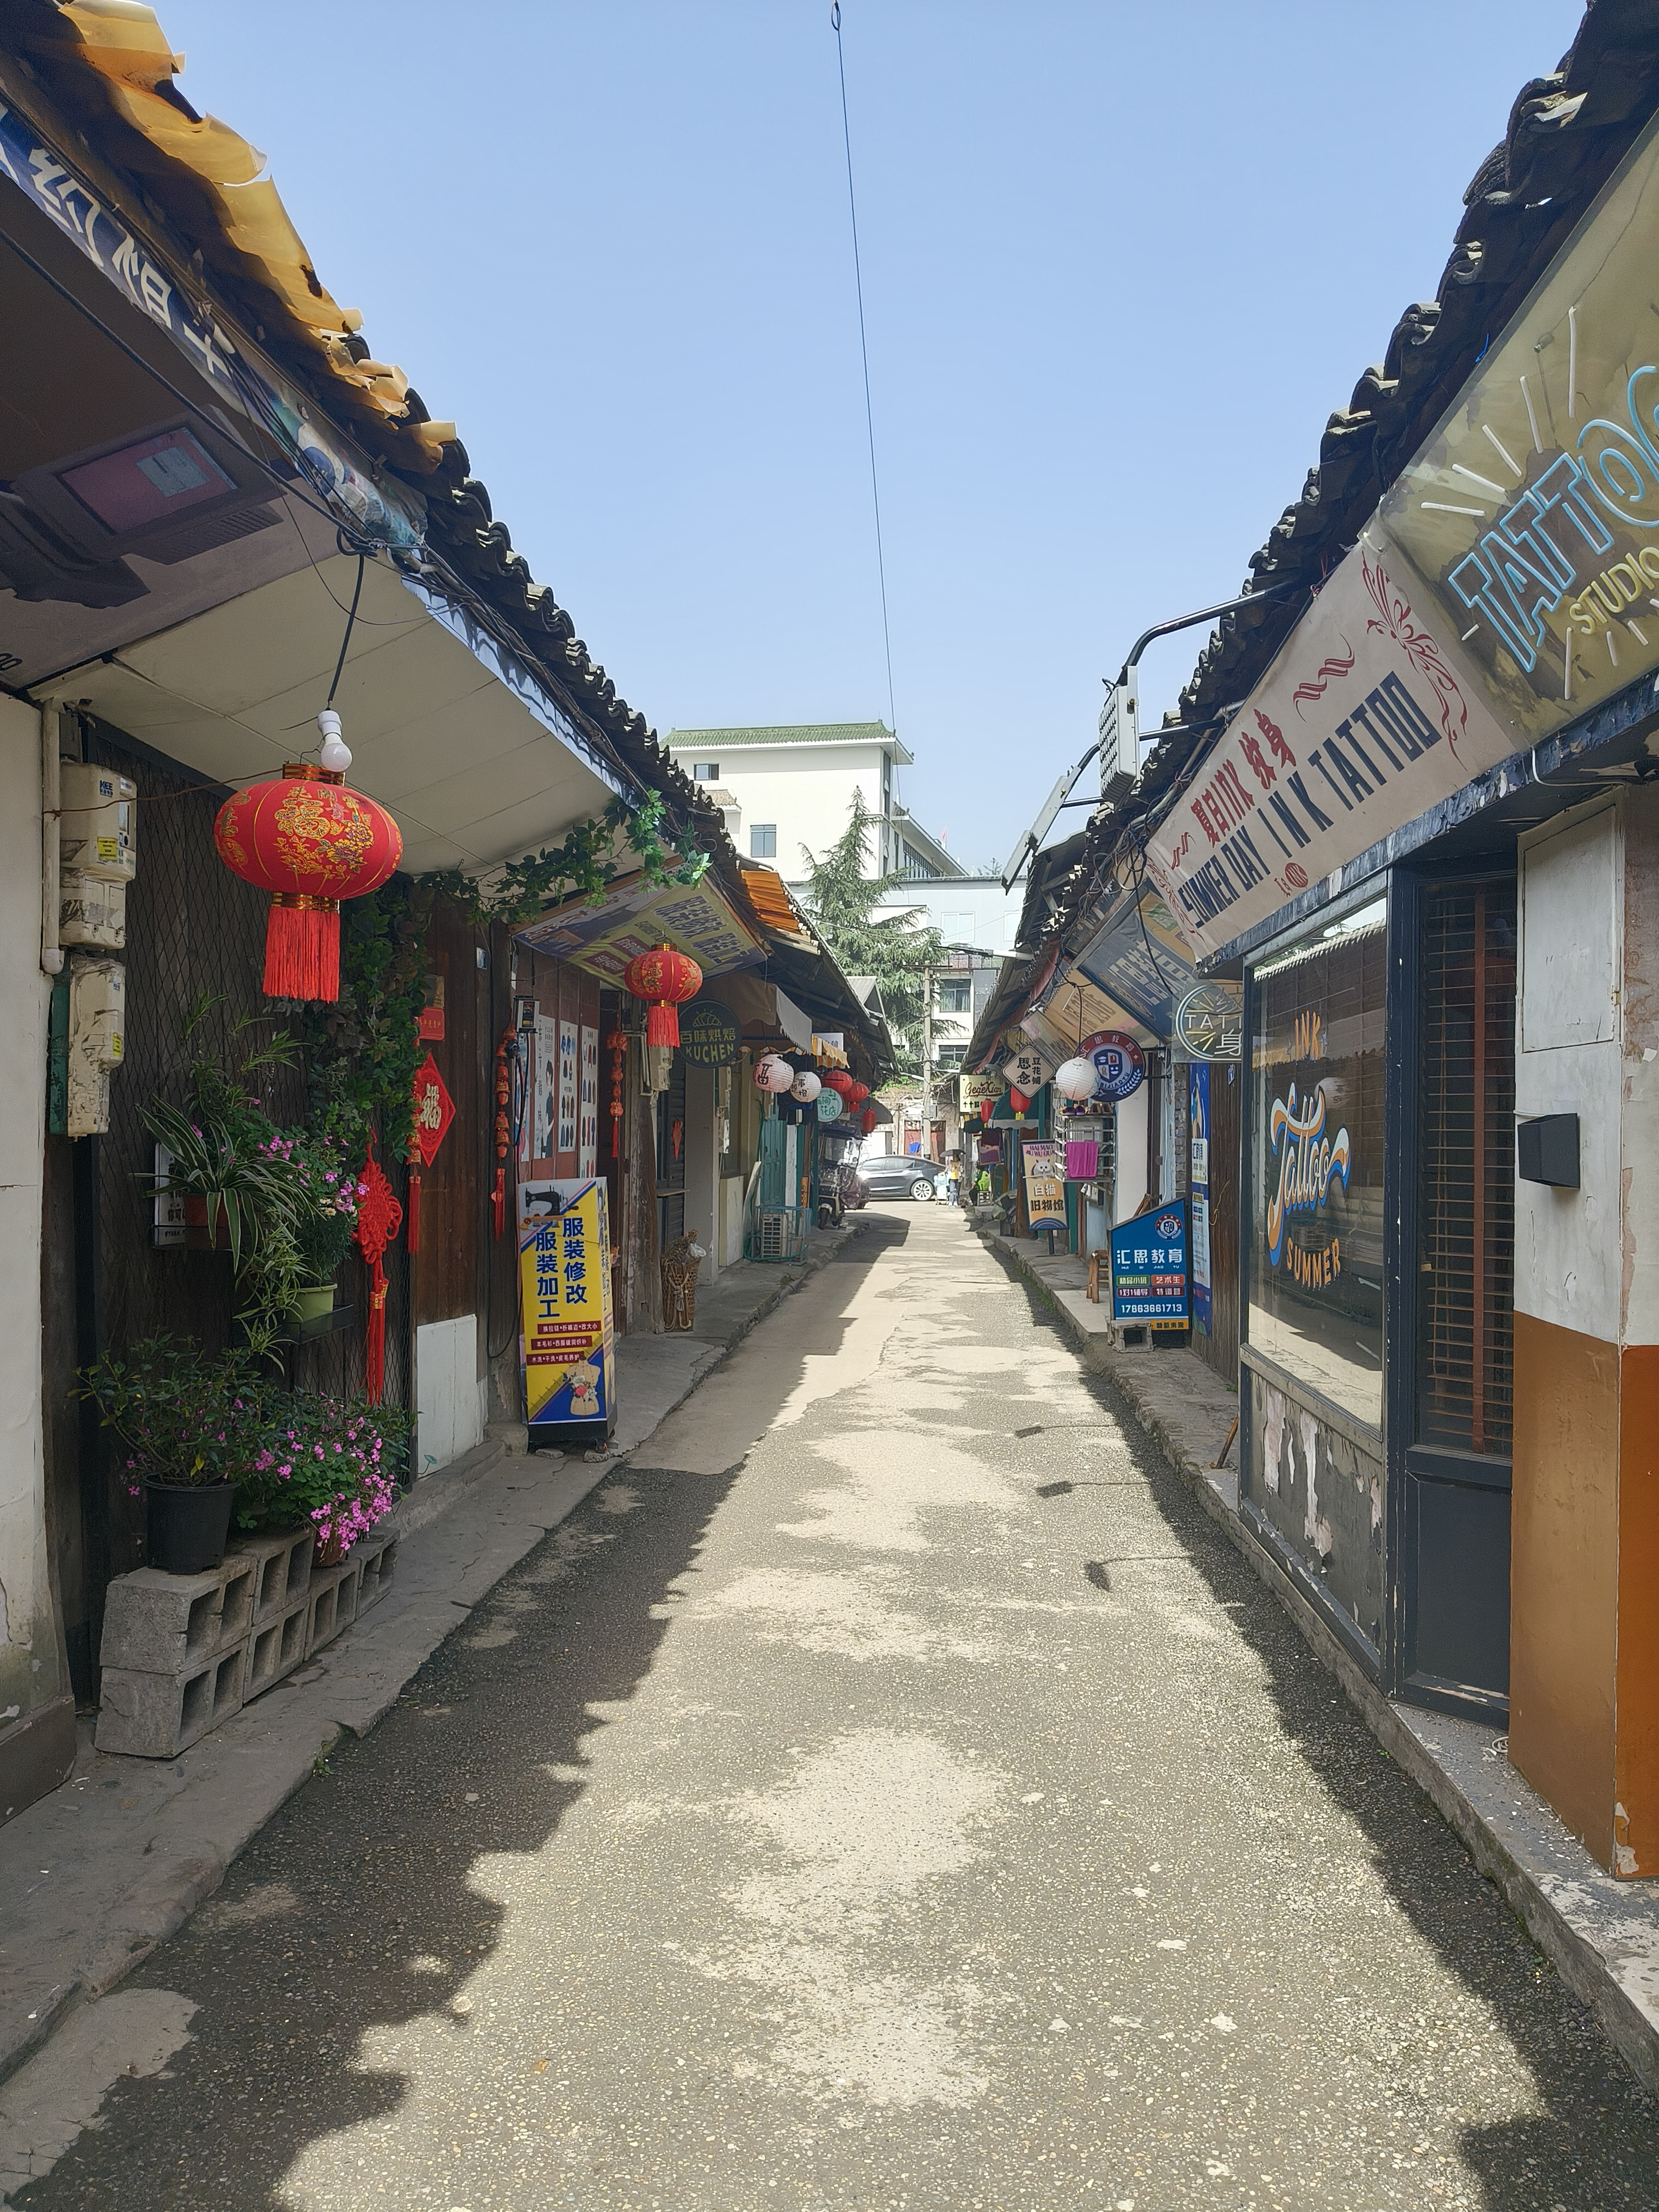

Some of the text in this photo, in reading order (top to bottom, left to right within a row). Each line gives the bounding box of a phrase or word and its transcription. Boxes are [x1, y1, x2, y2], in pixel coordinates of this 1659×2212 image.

[1238, 709, 1296, 790] 纹身
[1178, 671, 1442, 928] SUMMER DAY INK TATTOO
[680, 1028, 735, 1043] 百味烘焙
[1295, 1010, 1320, 1061] INK
[686, 1043, 733, 1063] KUCHEN
[1016, 1057, 1030, 1084] 思念
[820, 1105, 836, 1116] 花店
[1267, 1082, 1350, 1266] Tattoo
[1034, 1183, 1056, 1196] 白猫
[1030, 1199, 1064, 1212] 旧物馆
[562, 1217, 587, 1305] 服装修改
[1116, 1249, 1182, 1264] 汇思教育
[1287, 1237, 1341, 1289] SUMMER
[535, 1232, 560, 1318] 服装加工
[1119, 1276, 1147, 1284] 精品小班
[1120, 1289, 1148, 1297] 1对1辅导
[1121, 1304, 1182, 1313] 17863661713
